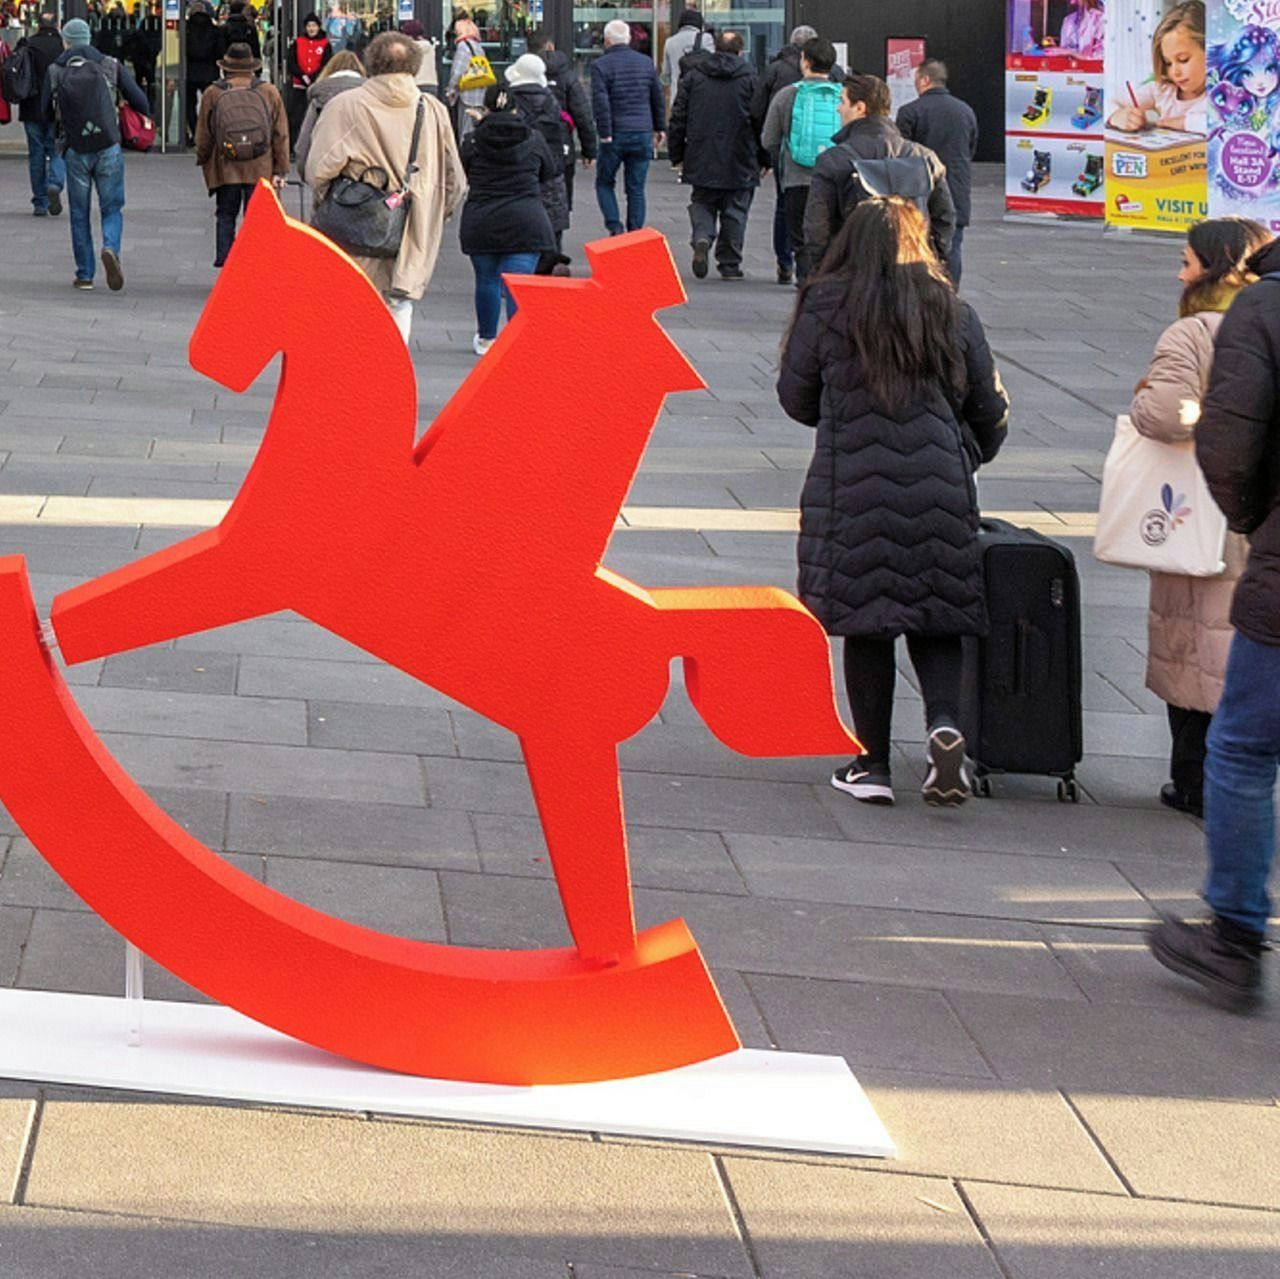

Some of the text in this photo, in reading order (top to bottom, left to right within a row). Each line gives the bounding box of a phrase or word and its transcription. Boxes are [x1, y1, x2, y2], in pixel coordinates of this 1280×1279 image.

[1116, 159, 1144, 174] PEN
[1234, 165, 1262, 176] Stand
[1154, 198, 1194, 215] VISIT
